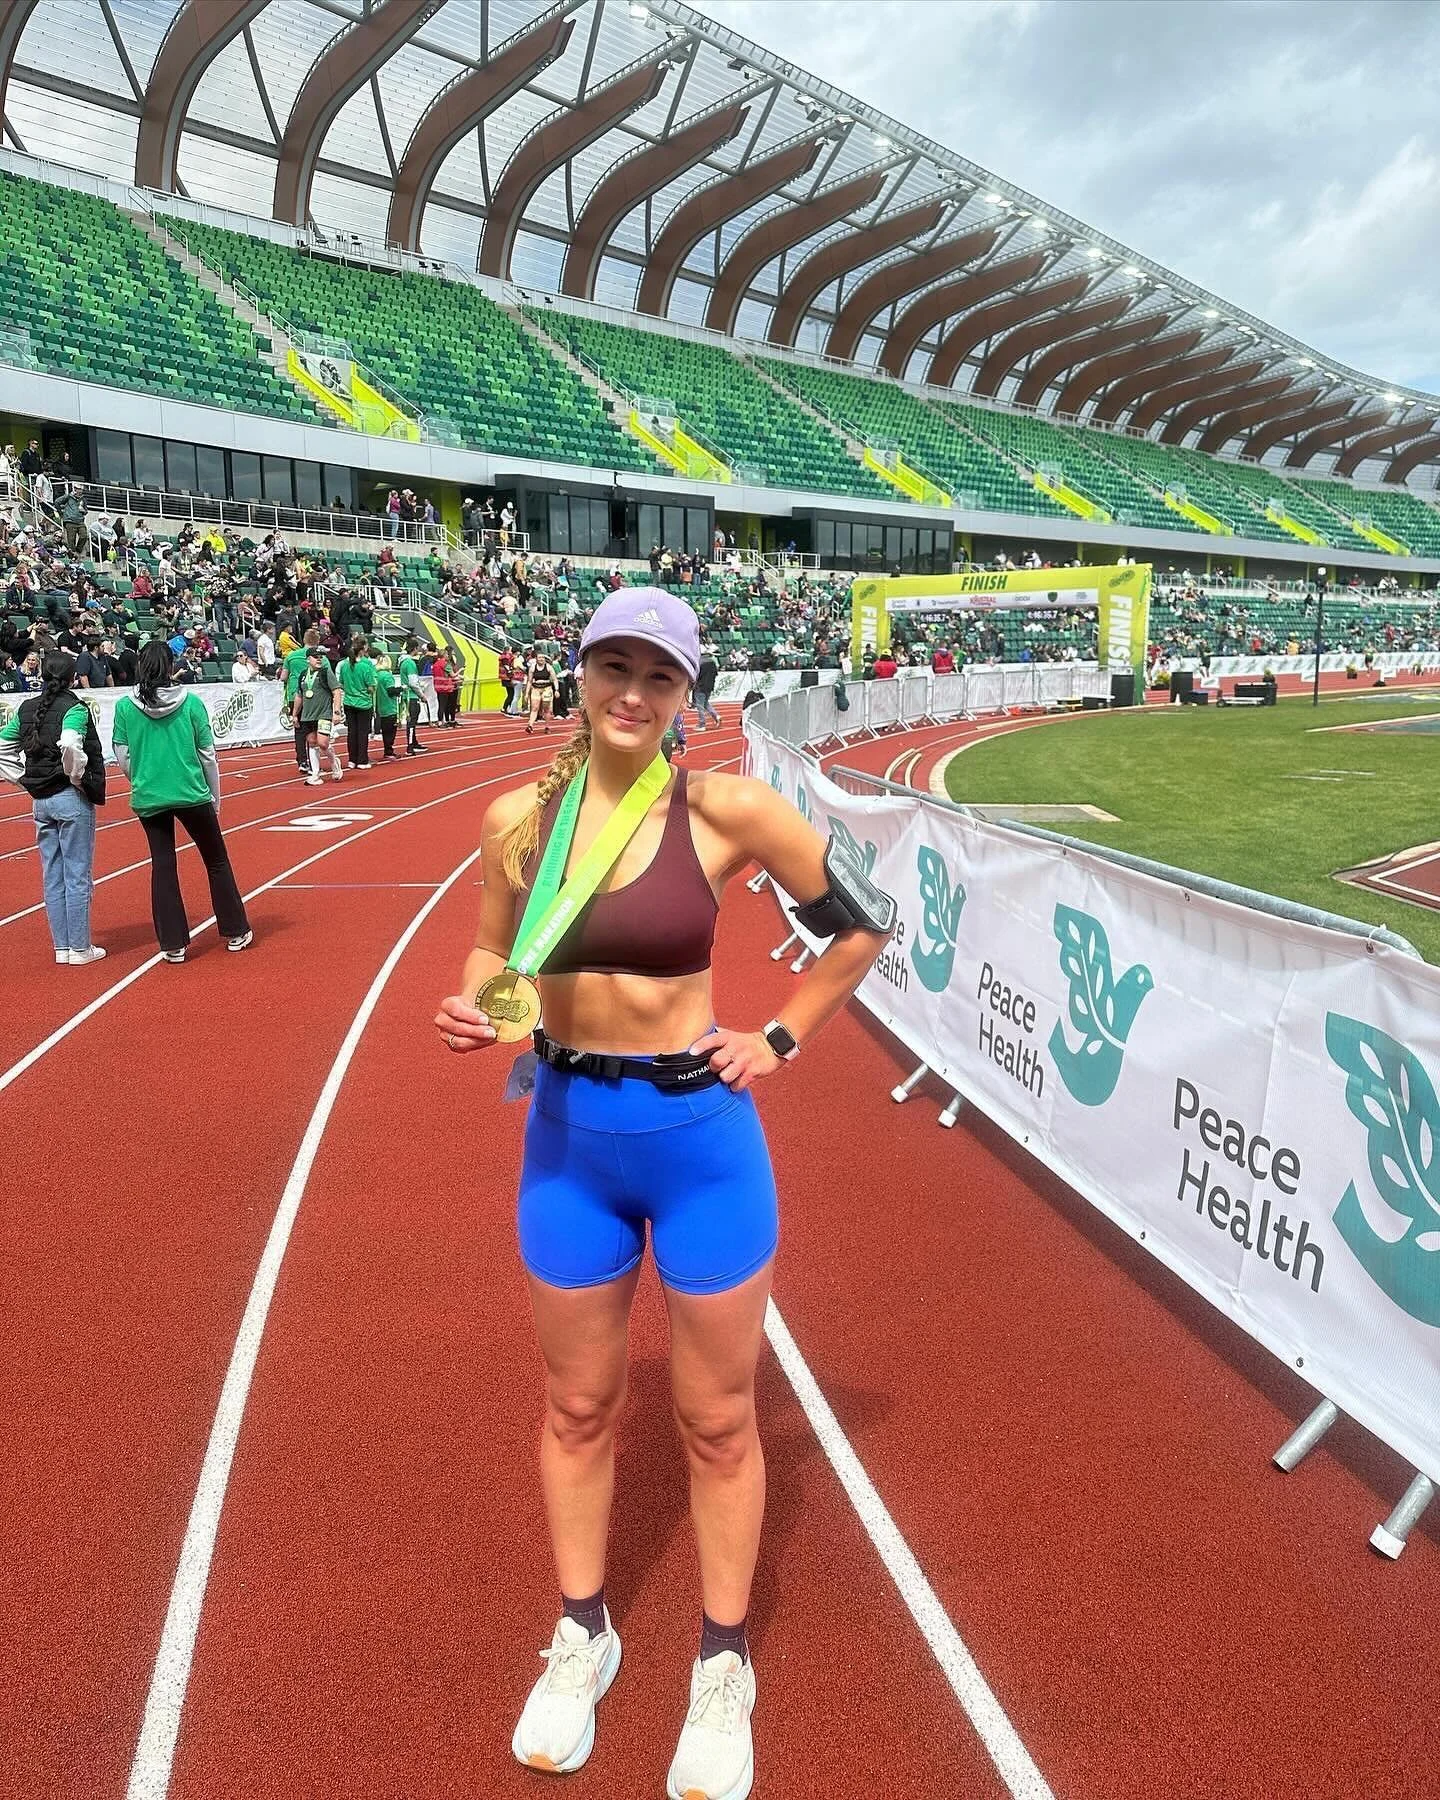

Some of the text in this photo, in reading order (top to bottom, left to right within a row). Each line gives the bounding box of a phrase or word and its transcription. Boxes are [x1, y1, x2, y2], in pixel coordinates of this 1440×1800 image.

[961, 574, 1008, 591] FINISH
[372, 613, 402, 625] KS
[861, 605, 877, 660] FINI
[1108, 594, 1133, 676] FINISH
[218, 693, 250, 732] EUGENE
[873, 951, 909, 993] ealth
[977, 961, 1036, 1034] Peace
[979, 1012, 1044, 1098] Health
[1173, 1077, 1301, 1195] Peace
[1177, 1148, 1324, 1293] Health
